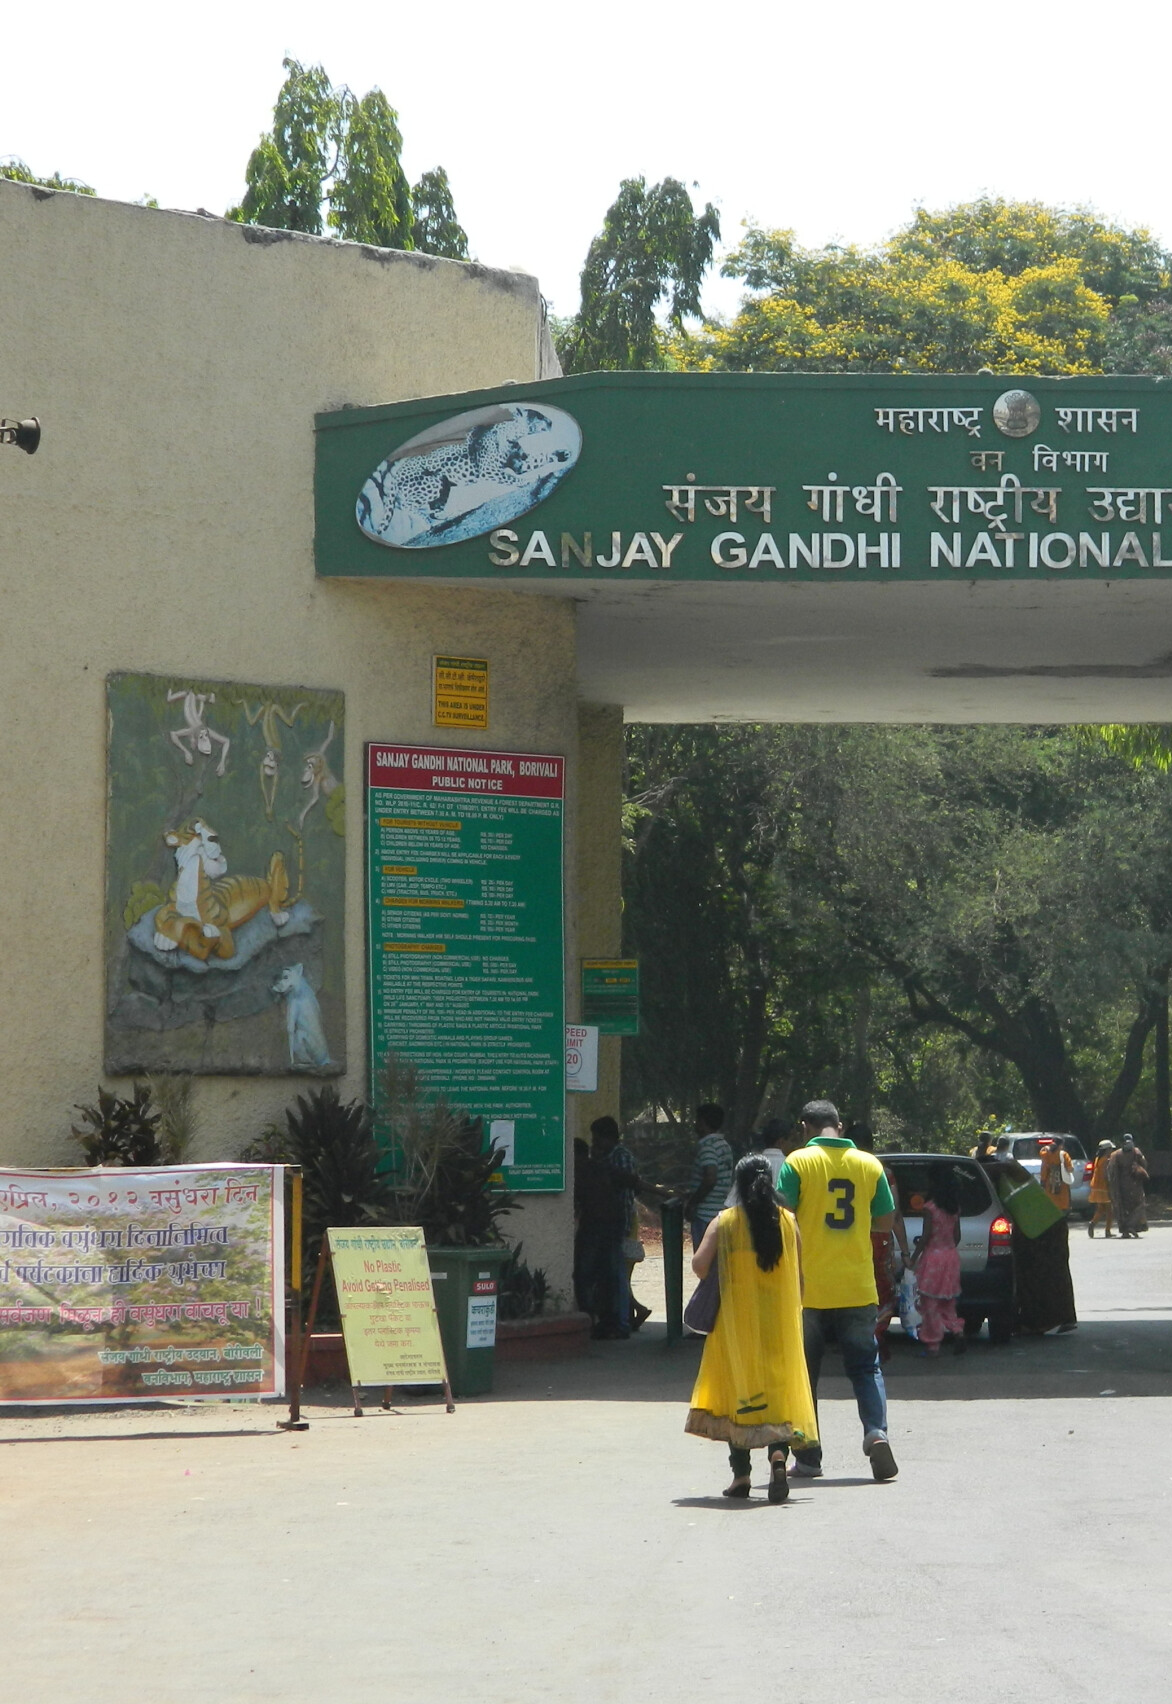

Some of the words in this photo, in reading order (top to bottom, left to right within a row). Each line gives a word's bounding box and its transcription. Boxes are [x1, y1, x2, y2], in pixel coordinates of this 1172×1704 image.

[874, 407, 983, 438] महाराष्ट्र
[1055, 408, 1140, 433] शासन
[970, 450, 1006, 472] वन
[1032, 444, 1109, 473] विभाग
[662, 472, 776, 523] संजय
[802, 472, 903, 523] गांधी
[927, 473, 1062, 532] राष्ट्रीय
[488, 531, 684, 569] SANJAY
[710, 531, 900, 569] GANDHI
[376, 750, 409, 768] SANJAY
[411, 753, 444, 770] GANDHI
[447, 755, 488, 773] NATIONAL
[490, 758, 514, 778] PARK,
[519, 760, 557, 777] BORIVALI
[432, 775, 465, 788] PUBLIC
[468, 777, 502, 790] NOTICE
[565, 1027, 588, 1038] PEED
[566, 1038, 584, 1048] IMIT
[567, 1053, 579, 1065] 20
[149, 1179, 219, 1214] वसुंधरा
[225, 1178, 260, 1205] दिन
[825, 1178, 855, 1230] 3
[61, 1224, 123, 1254] वसुंधरा
[15, 1260, 104, 1284] पर्यटकांना
[107, 1258, 163, 1284] हार्दिक
[363, 1260, 375, 1273] No
[376, 1259, 402, 1273] Plastic
[342, 1279, 363, 1293] Avoid
[393, 1278, 430, 1292] Penalised
[476, 1282, 495, 1291] SULO
[129, 1301, 182, 1328] वसुंधरा
[98, 1347, 127, 1364] संजय
[223, 1342, 264, 1360] बोरीवली
[233, 1369, 264, 1383] शासन
